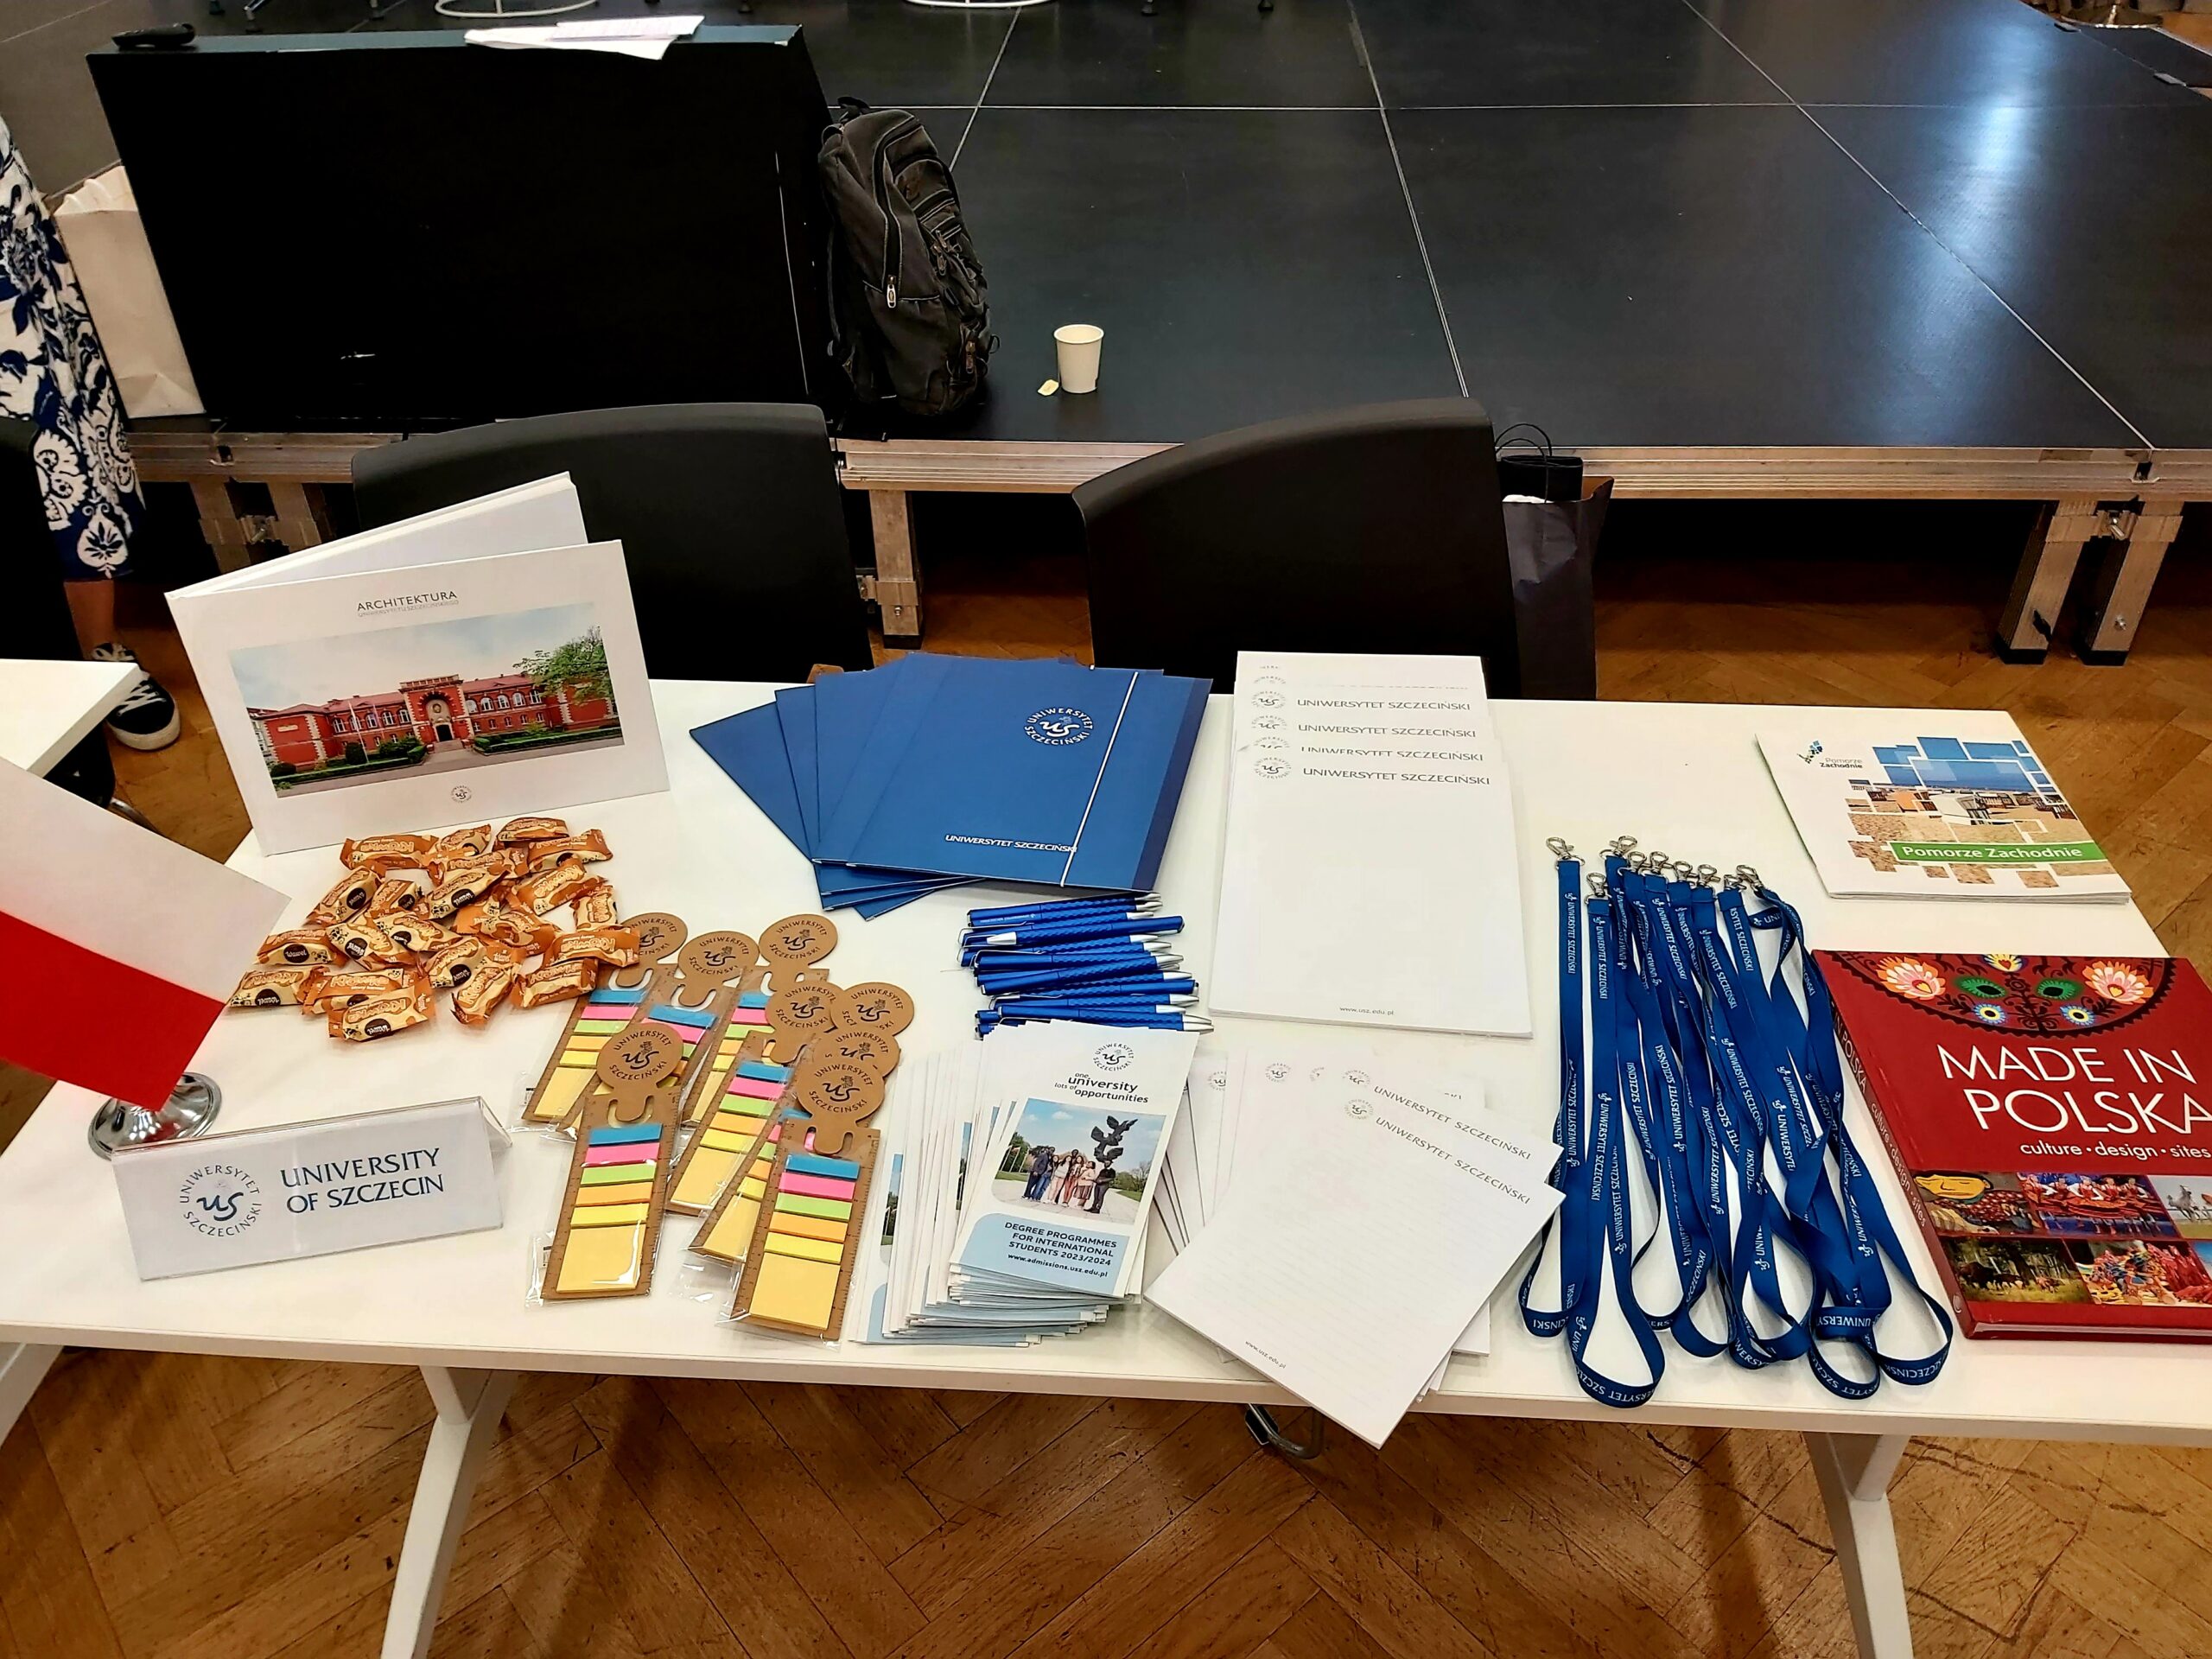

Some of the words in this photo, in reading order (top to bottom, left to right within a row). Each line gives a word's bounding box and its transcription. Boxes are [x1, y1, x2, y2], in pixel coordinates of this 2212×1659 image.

[357, 591, 457, 611] ARCHITEKTURA
[1297, 699, 1384, 709] UNIWERSYTET
[1027, 708, 1093, 729] UNIWERSYTET
[1299, 724, 1388, 734] UNIWERSYTET
[1303, 767, 1396, 780] UNIWERSYTET
[945, 835, 1014, 848] UNIWERSYTET
[1902, 846, 1983, 859] Pomorze
[1985, 844, 2082, 859] Zachodnie
[777, 919, 828, 936] UNIWERSYTET
[1656, 907, 1675, 944] UNIWERSYTET
[1730, 907, 1743, 931] RSYTET
[1595, 924, 1607, 962] UNIWERSYTET
[850, 988, 904, 1010] UNIWERSYTET
[1339, 1007, 1394, 1016] www.usz.edu.pl
[613, 1030, 671, 1051] UNIWERSYTET
[836, 1031, 889, 1053] UNIWERSYTET
[814, 1064, 874, 1086] UNIWERSYTET
[1726, 1048, 1749, 1089] UNIWERSYTET
[1842, 1035, 1867, 1094] POLSKA
[1936, 1044, 2115, 1084] MADE
[2123, 1048, 2196, 1084] IN
[1068, 1077, 1138, 1093] university
[1075, 1089, 1148, 1103] opportunities
[1374, 1086, 1452, 1123] UNIWERSYTET
[1669, 1084, 1683, 1140] UNIWERSYTET
[1963, 1088, 2212, 1134] POLSKA
[1376, 1117, 1452, 1160] UNIWERSYTET
[1567, 1108, 1577, 1156] UNIWERSYTET
[1599, 1103, 1610, 1154] UNIWERSYTET
[2020, 1140, 2082, 1156] culture
[2094, 1141, 2157, 1160] design
[2170, 1145, 2211, 1159] sites
[281, 1147, 440, 1187] UNIVERSITY
[1710, 1149, 1720, 1204] UNIWERSYTET
[1871, 1103, 1890, 1144] culture
[1891, 1147, 1911, 1192] design
[1911, 1195, 1927, 1228] sites
[179, 1164, 260, 1204] UNIWERSYTET
[287, 1192, 319, 1214] OF
[328, 1173, 445, 1208] SZCZECIN
[1612, 1192, 1624, 1242] UNIWERSYTET
[1005, 1222, 1045, 1236] DEGREE
[1046, 1230, 1117, 1248] PROGRAMMES
[1013, 1232, 1033, 1243] FOR
[1035, 1237, 1114, 1257] INTERNATIONAL
[1007, 1254, 1108, 1278] www.admissions.usz.edu.pl
[1008, 1241, 1058, 1256] STUDENTS
[1061, 1251, 1111, 1266] 2023/2024
[1817, 1315, 1872, 1327] UNIWERSY
